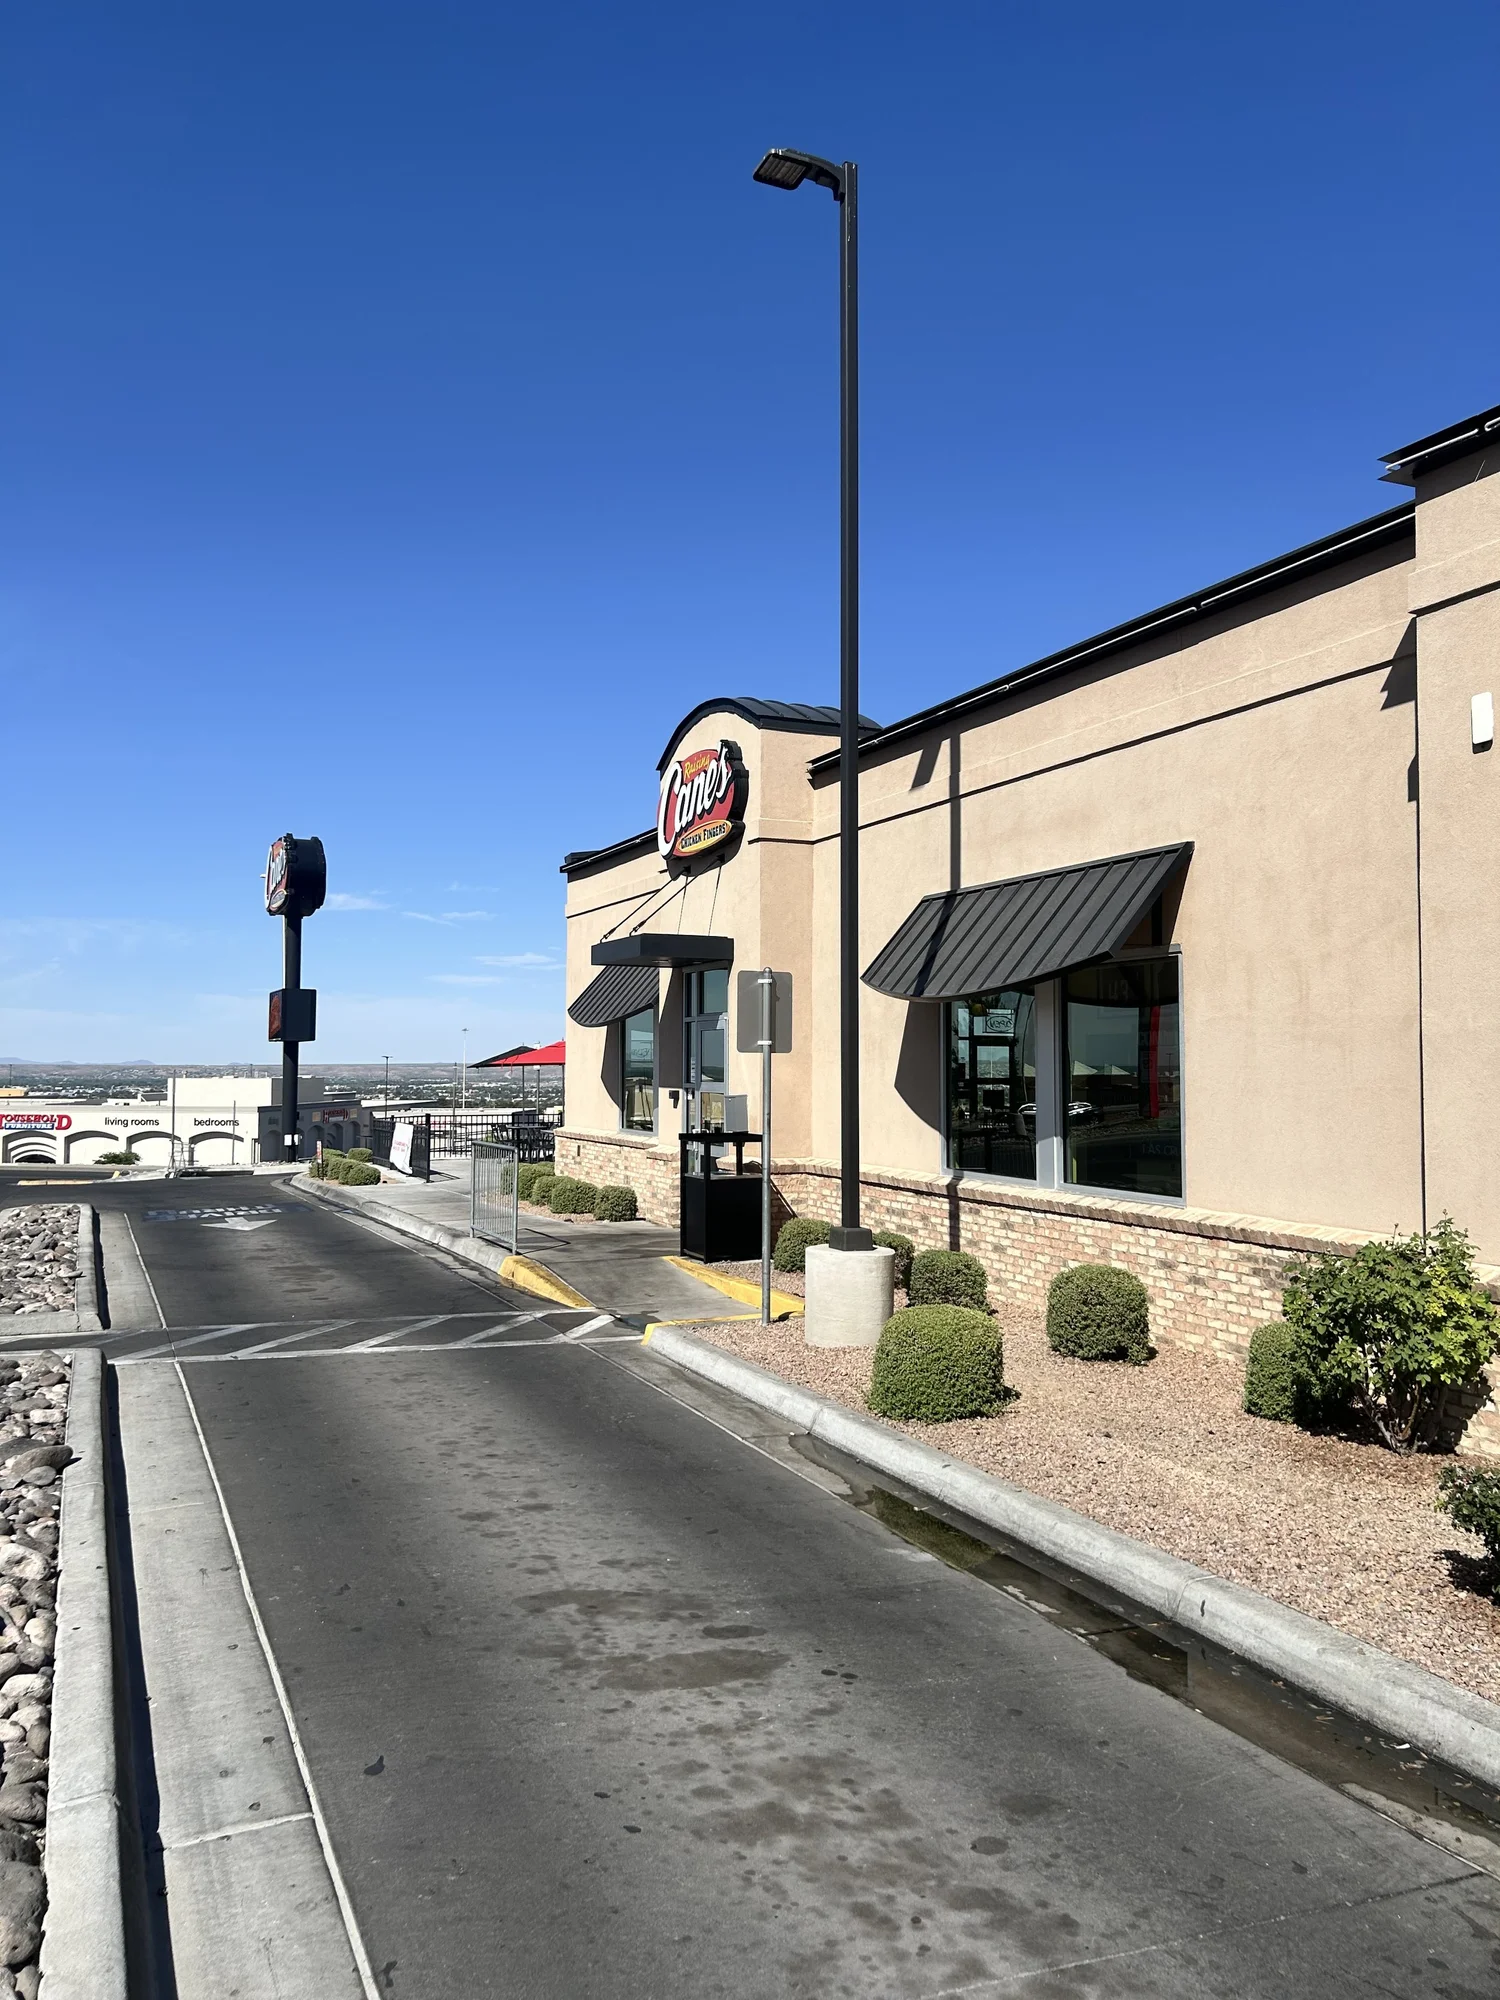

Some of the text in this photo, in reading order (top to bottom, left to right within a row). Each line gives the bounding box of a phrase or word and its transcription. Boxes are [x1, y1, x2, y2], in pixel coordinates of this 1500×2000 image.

[684, 754, 711, 779] Raising
[681, 823, 726, 849] CHICKEN FINGERS
[105, 1117, 128, 1127] living
[194, 1118, 239, 1127] bedrooms
